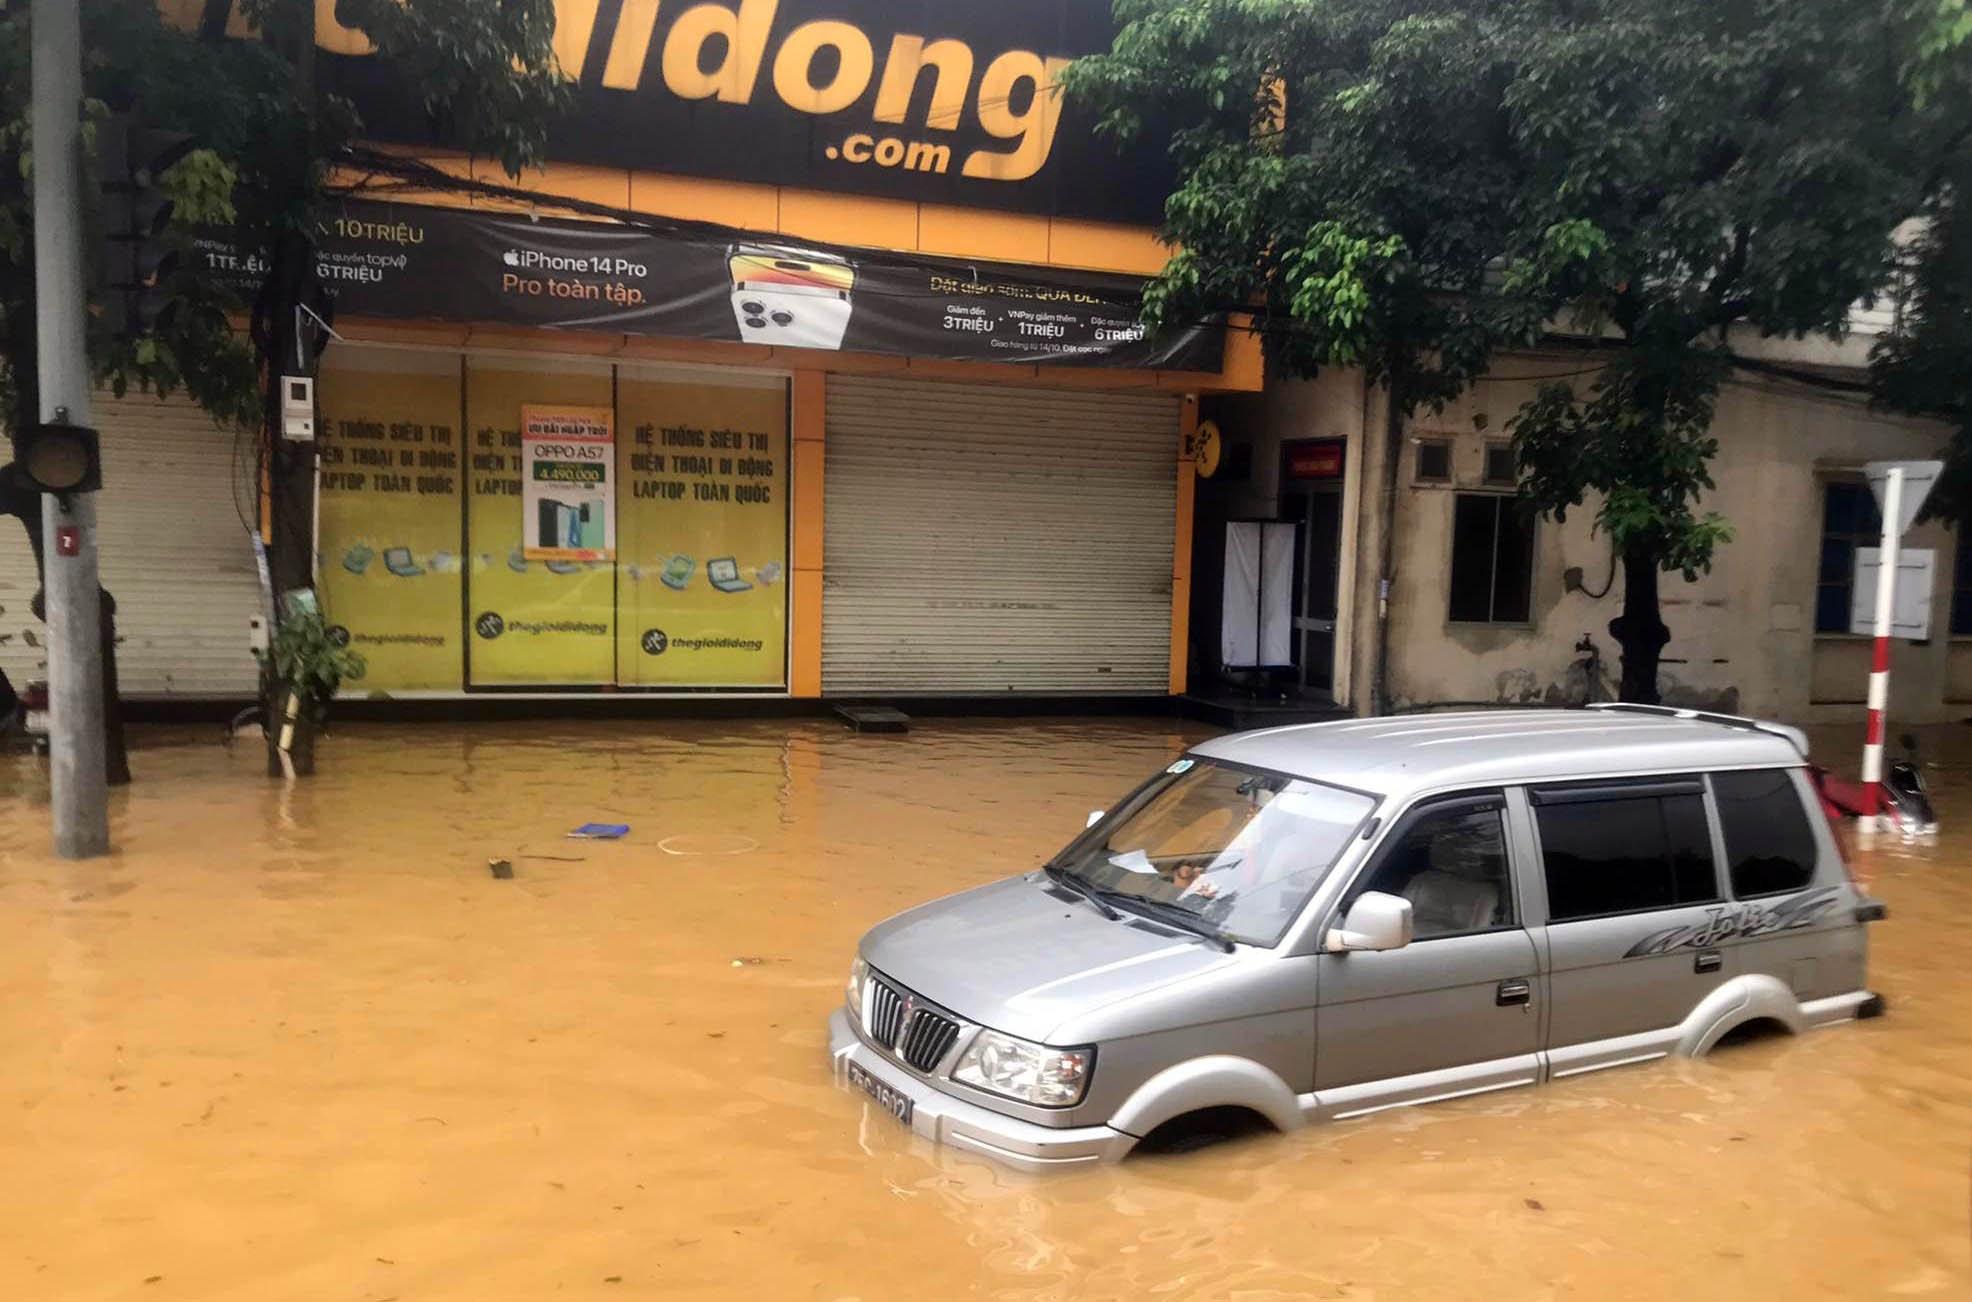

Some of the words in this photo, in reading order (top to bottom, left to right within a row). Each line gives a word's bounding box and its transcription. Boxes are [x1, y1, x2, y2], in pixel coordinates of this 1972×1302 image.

[824, 132, 952, 175] .com
[520, 250, 588, 273] iPhone
[589, 256, 612, 274] 14
[615, 259, 648, 278] Pro
[502, 273, 542, 296] Pro
[548, 278, 600, 300] toàn
[604, 282, 648, 307] tập.
[943, 315, 995, 335] 3TRIỆU
[1007, 309, 1035, 321] VNPay
[1035, 312, 1056, 323] giảm
[1018, 321, 1065, 340] 1TRIỆU
[1094, 327, 1144, 344] 6TRIỆU
[660, 424, 705, 448] THỐNG
[710, 428, 742, 450] SIÊU
[534, 444, 576, 459] OPPO
[577, 445, 605, 460] A57
[671, 454, 713, 479] THOẠI
[719, 457, 733, 476] DI
[320, 471, 366, 490] APTOP
[632, 479, 686, 500] LAPTOP
[692, 479, 730, 503] TOÀN
[735, 480, 771, 505] QUỐC
[508, 620, 609, 637] thegioididong
[671, 636, 764, 653] thegioididong
